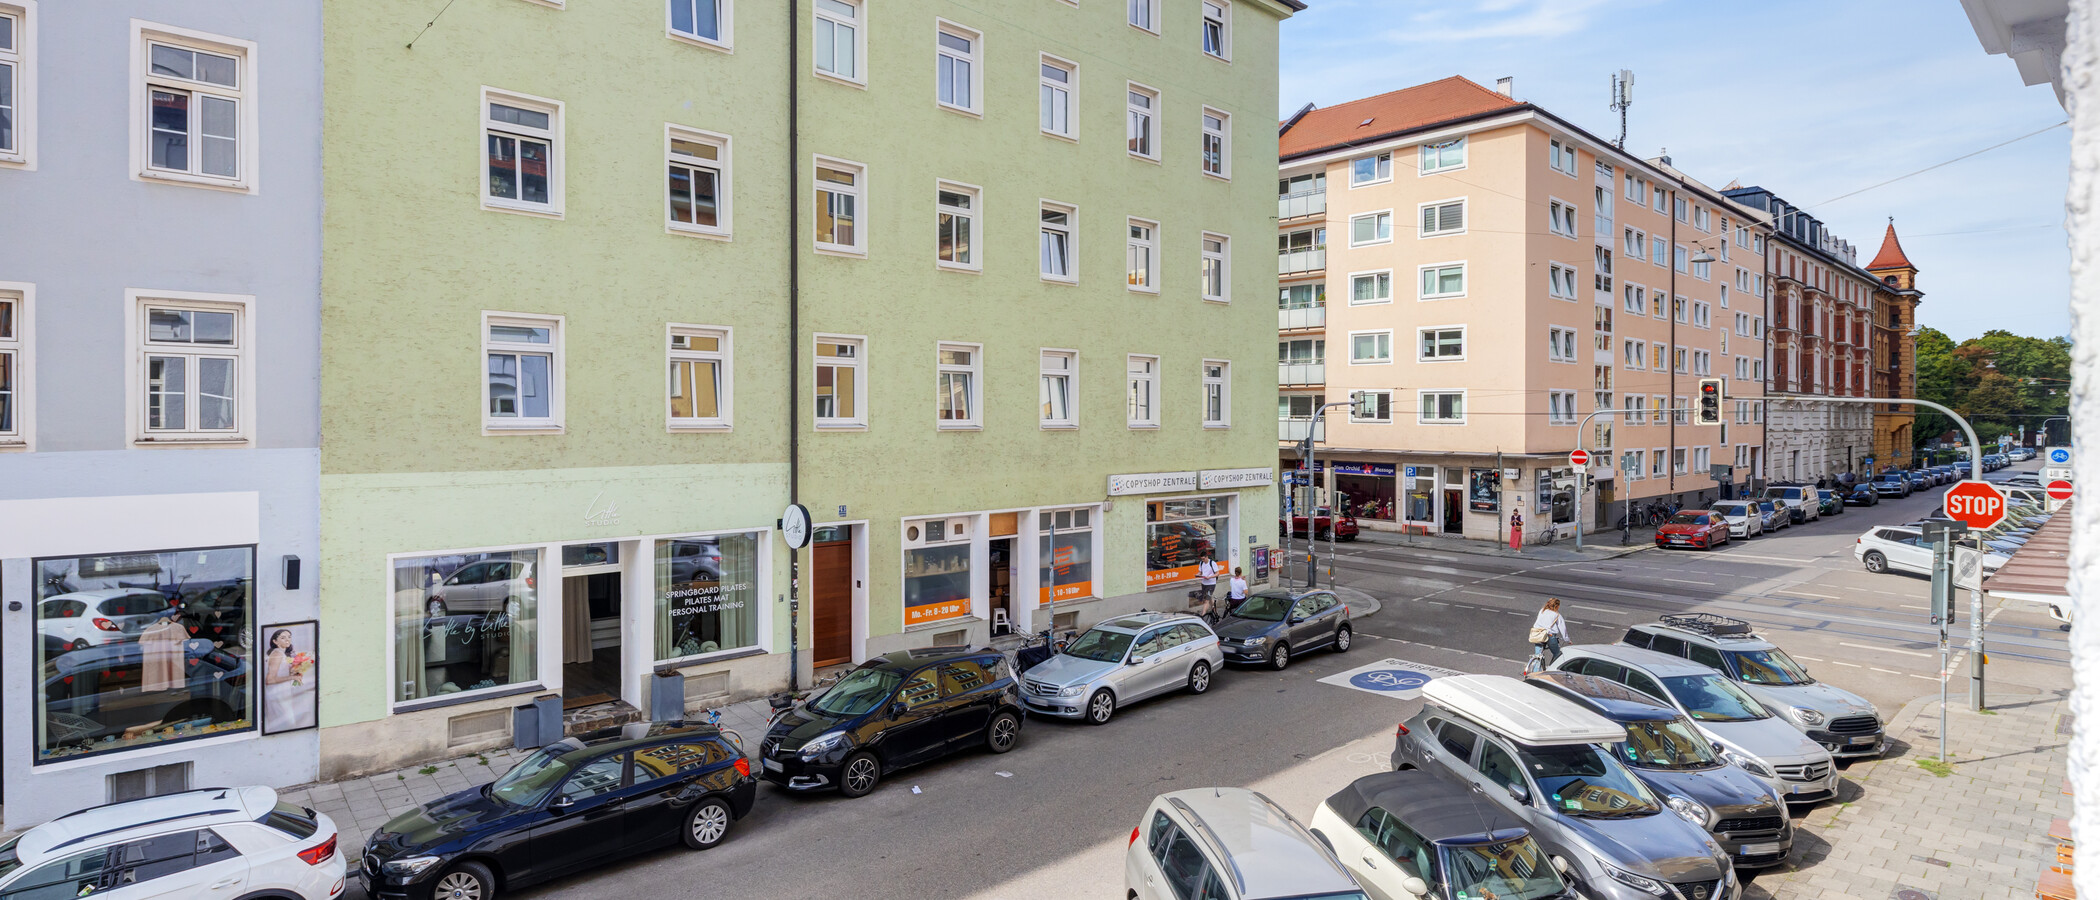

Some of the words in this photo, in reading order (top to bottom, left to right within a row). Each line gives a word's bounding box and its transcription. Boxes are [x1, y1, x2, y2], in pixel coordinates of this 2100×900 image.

[1126, 478, 1161, 488] COPYSHOP
[1163, 476, 1196, 486] ZENTRALE
[1214, 474, 1244, 483] COPYSHOP
[1245, 472, 1272, 481] ZENTRALE
[1950, 494, 2000, 516] STOP
[666, 586, 719, 598] SPRINGBOARD
[720, 583, 746, 592] PILATES
[684, 596, 712, 606] PILATES
[714, 594, 729, 602] MAT
[668, 606, 707, 616] PERSONAL
[709, 601, 744, 612] TRAINING
[462, 617, 476, 644] by
[480, 631, 512, 640] STUDIO
[1386, 660, 1464, 676] ahrradstraße
